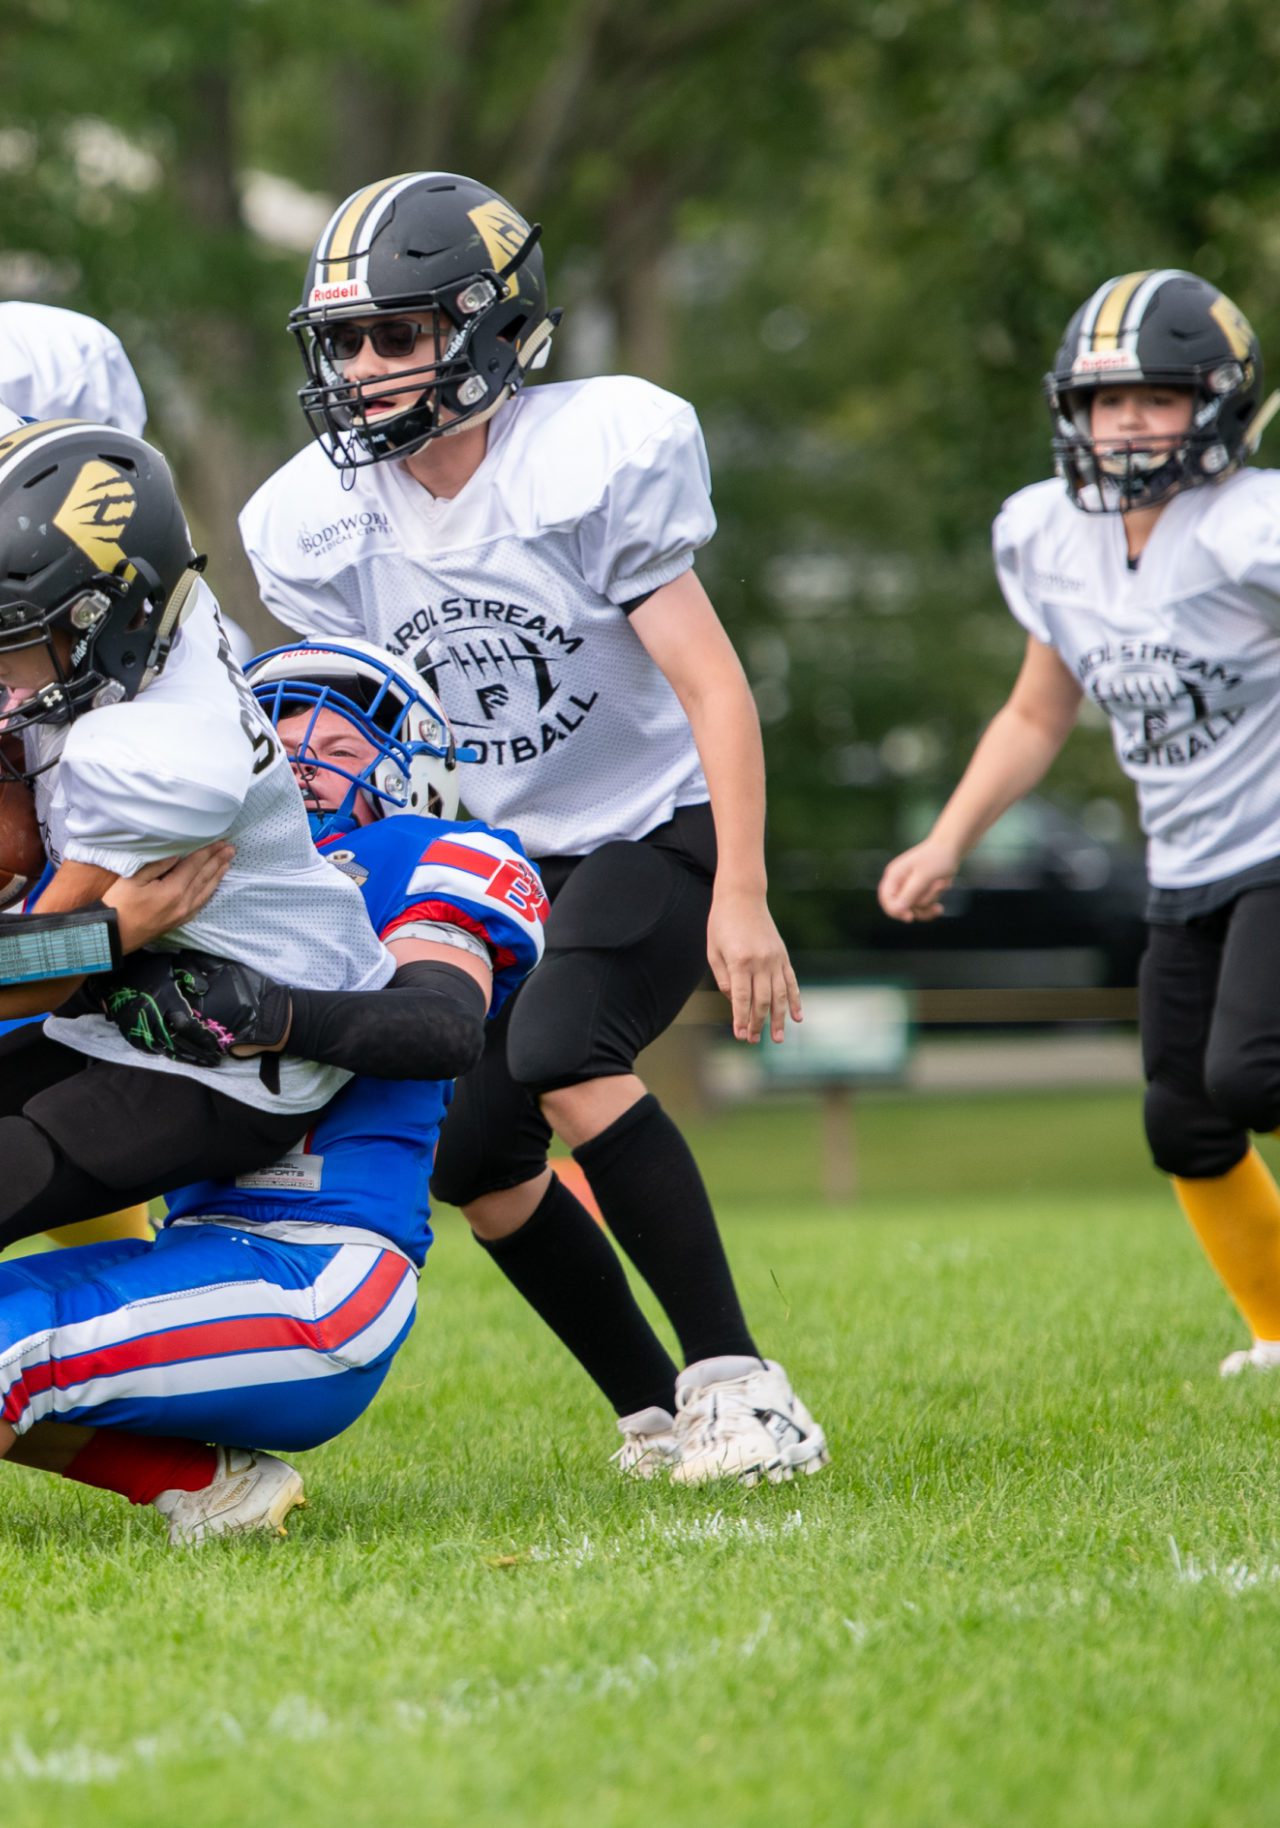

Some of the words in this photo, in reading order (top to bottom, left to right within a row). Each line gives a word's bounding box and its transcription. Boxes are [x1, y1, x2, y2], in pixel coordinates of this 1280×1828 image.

[314, 284, 359, 302] Riddell
[440, 597, 585, 655] STREAM
[1121, 640, 1243, 691] STREAM
[462, 691, 599, 766] OTBALL
